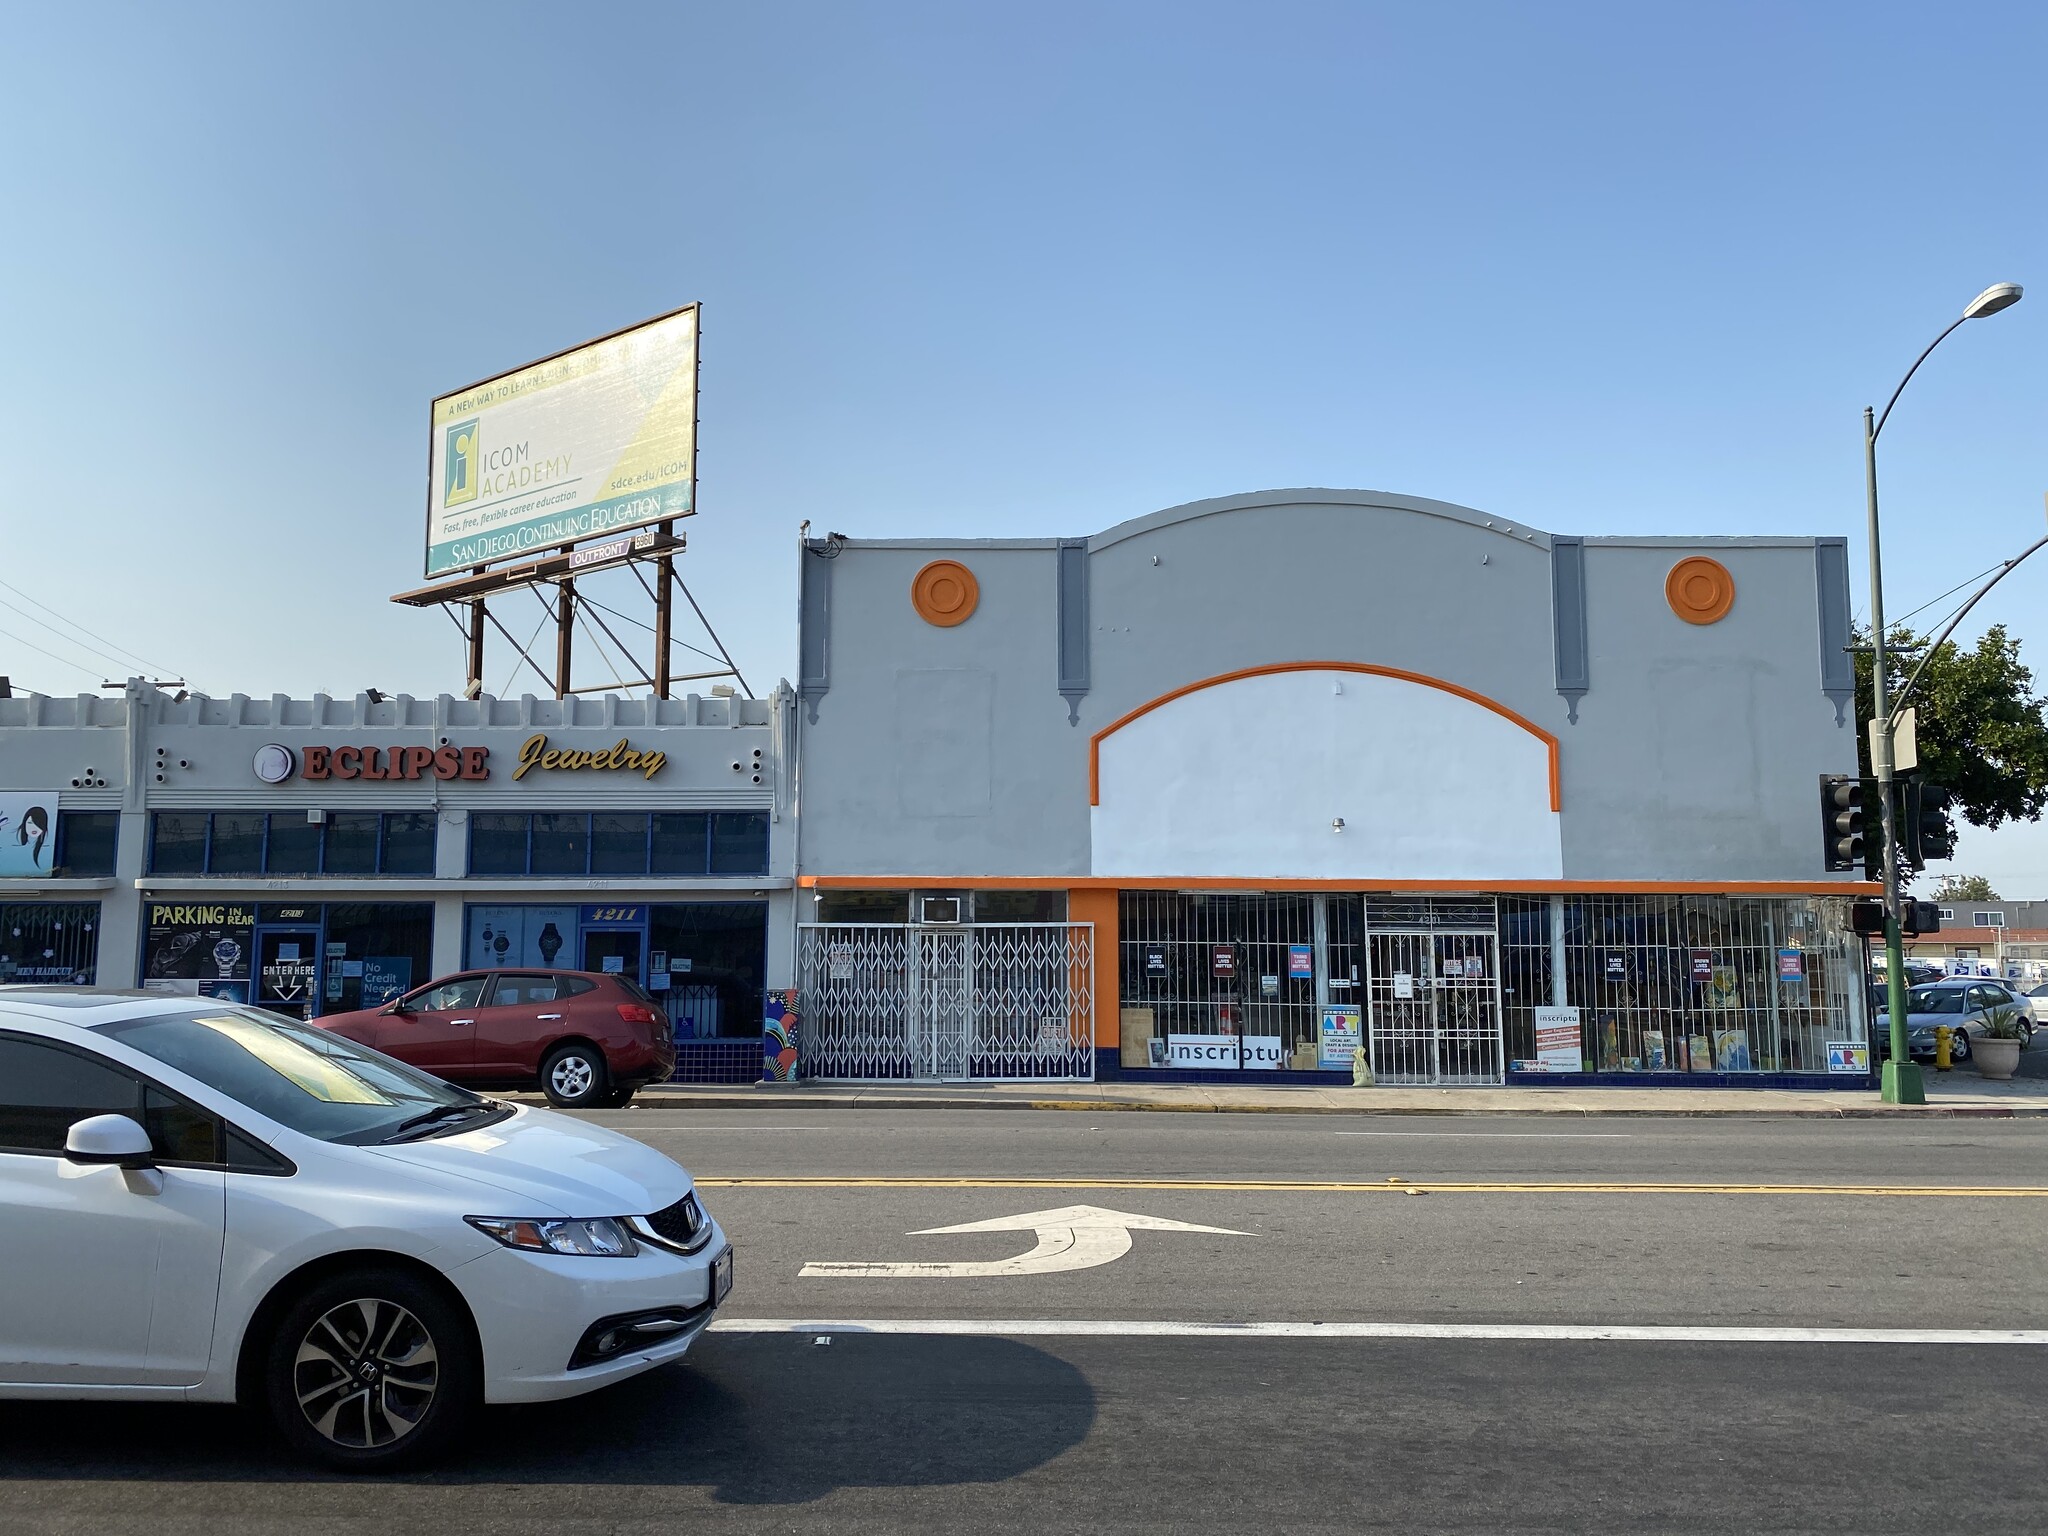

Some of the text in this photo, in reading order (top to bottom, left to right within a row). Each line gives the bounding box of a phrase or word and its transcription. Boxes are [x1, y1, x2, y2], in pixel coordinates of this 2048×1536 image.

[449, 406, 455, 416] A
[457, 399, 474, 413] NEW
[477, 391, 495, 405] WAY
[497, 387, 508, 398] TO
[511, 375, 539, 393] LEARN
[484, 441, 528, 473] ICOM
[482, 453, 572, 498] ACADEMY
[611, 461, 687, 490] sdce.edu/ICOM
[443, 490, 577, 534] Fast, free, flexible career education
[636, 534, 653, 547] 5960
[452, 543, 476, 566] SAN
[478, 532, 515, 558] DIEGO
[575, 543, 624, 564] OUTFRONT
[300, 733, 666, 782] ECLIPSE Jewelry
[229, 908, 242, 916] IN
[592, 908, 637, 921] 4211
[227, 915, 254, 925] REAR
[36, 967, 73, 975] HAIRCUT
[263, 966, 315, 975] ENTER HERE
[366, 963, 380, 972] No
[365, 973, 396, 983] Credit
[365, 984, 405, 993] Needed
[1324, 1016, 1359, 1030] ART
[1830, 1050, 1867, 1064] ART
